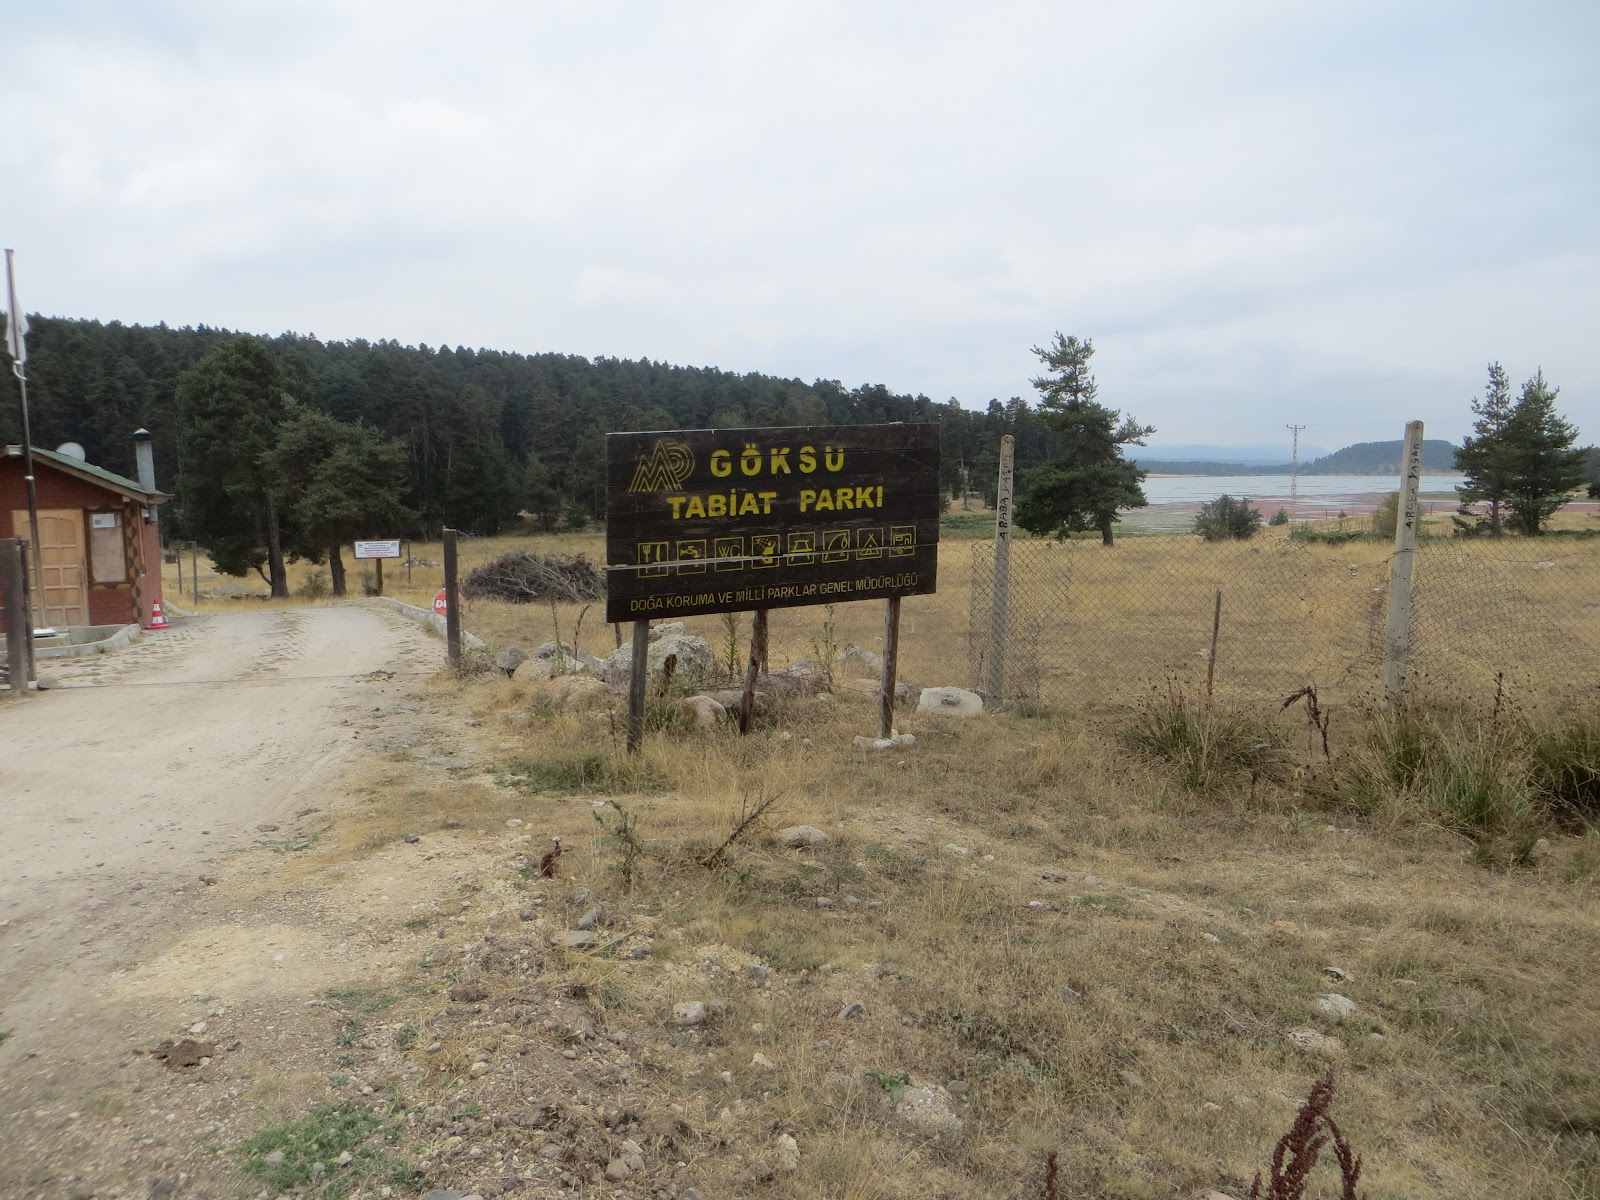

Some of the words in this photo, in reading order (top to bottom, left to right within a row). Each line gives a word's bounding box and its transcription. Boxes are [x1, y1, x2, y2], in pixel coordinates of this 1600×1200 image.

[710, 442, 845, 478] GÖKSU
[666, 488, 777, 520] TABİAT
[799, 485, 884, 513] PARKI
[718, 544, 741, 559] WC
[630, 595, 663, 612] DOĞA
[666, 593, 716, 609] KORUMA
[717, 591, 734, 604] VE
[735, 587, 765, 602] MİLLİ
[767, 583, 817, 599] PARKLAR
[819, 580, 853, 595] GENEL
[855, 572, 918, 591] MÜDÜRLÜĞÜ
